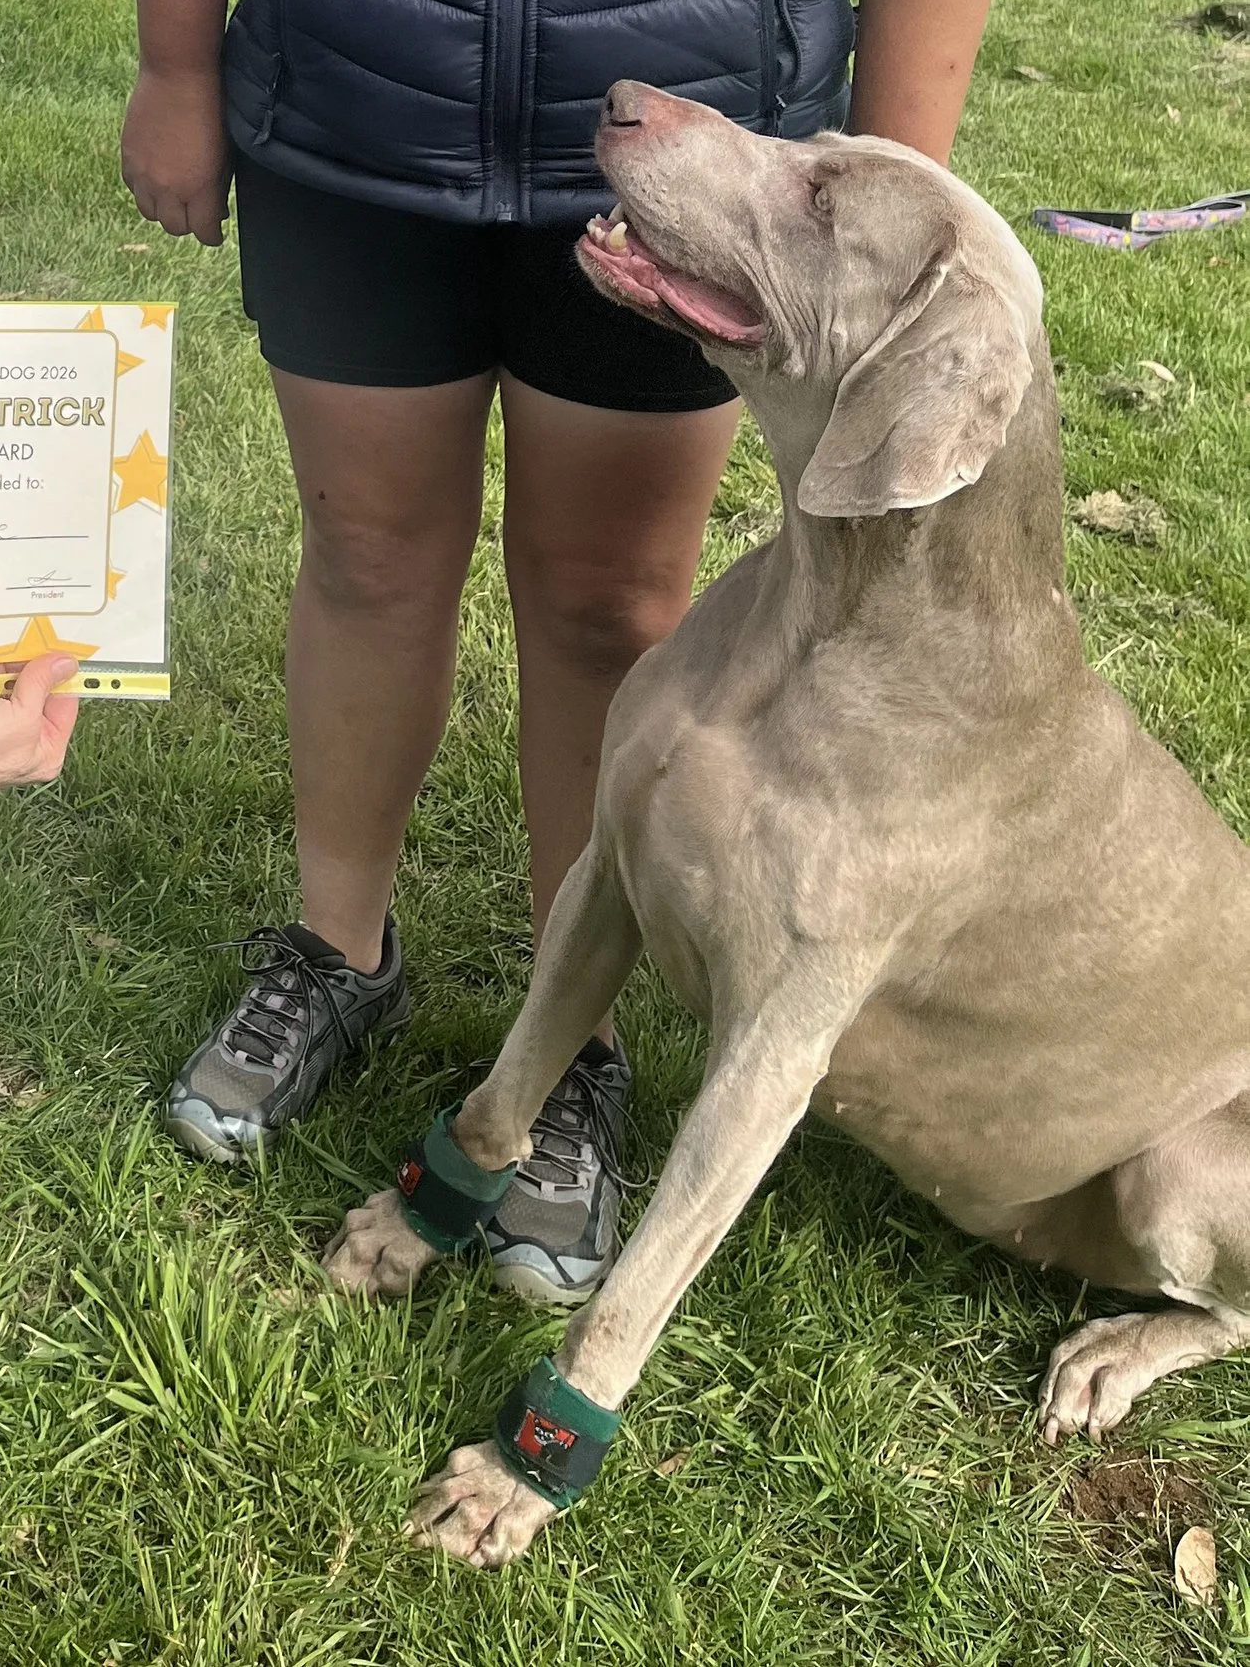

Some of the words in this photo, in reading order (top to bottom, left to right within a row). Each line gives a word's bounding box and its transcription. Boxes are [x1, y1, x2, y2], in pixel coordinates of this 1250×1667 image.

[0, 366, 36, 380] DOG
[40, 366, 78, 380] 2026
[26, 476, 44, 490] to:
[30, 590, 65, 600] President
